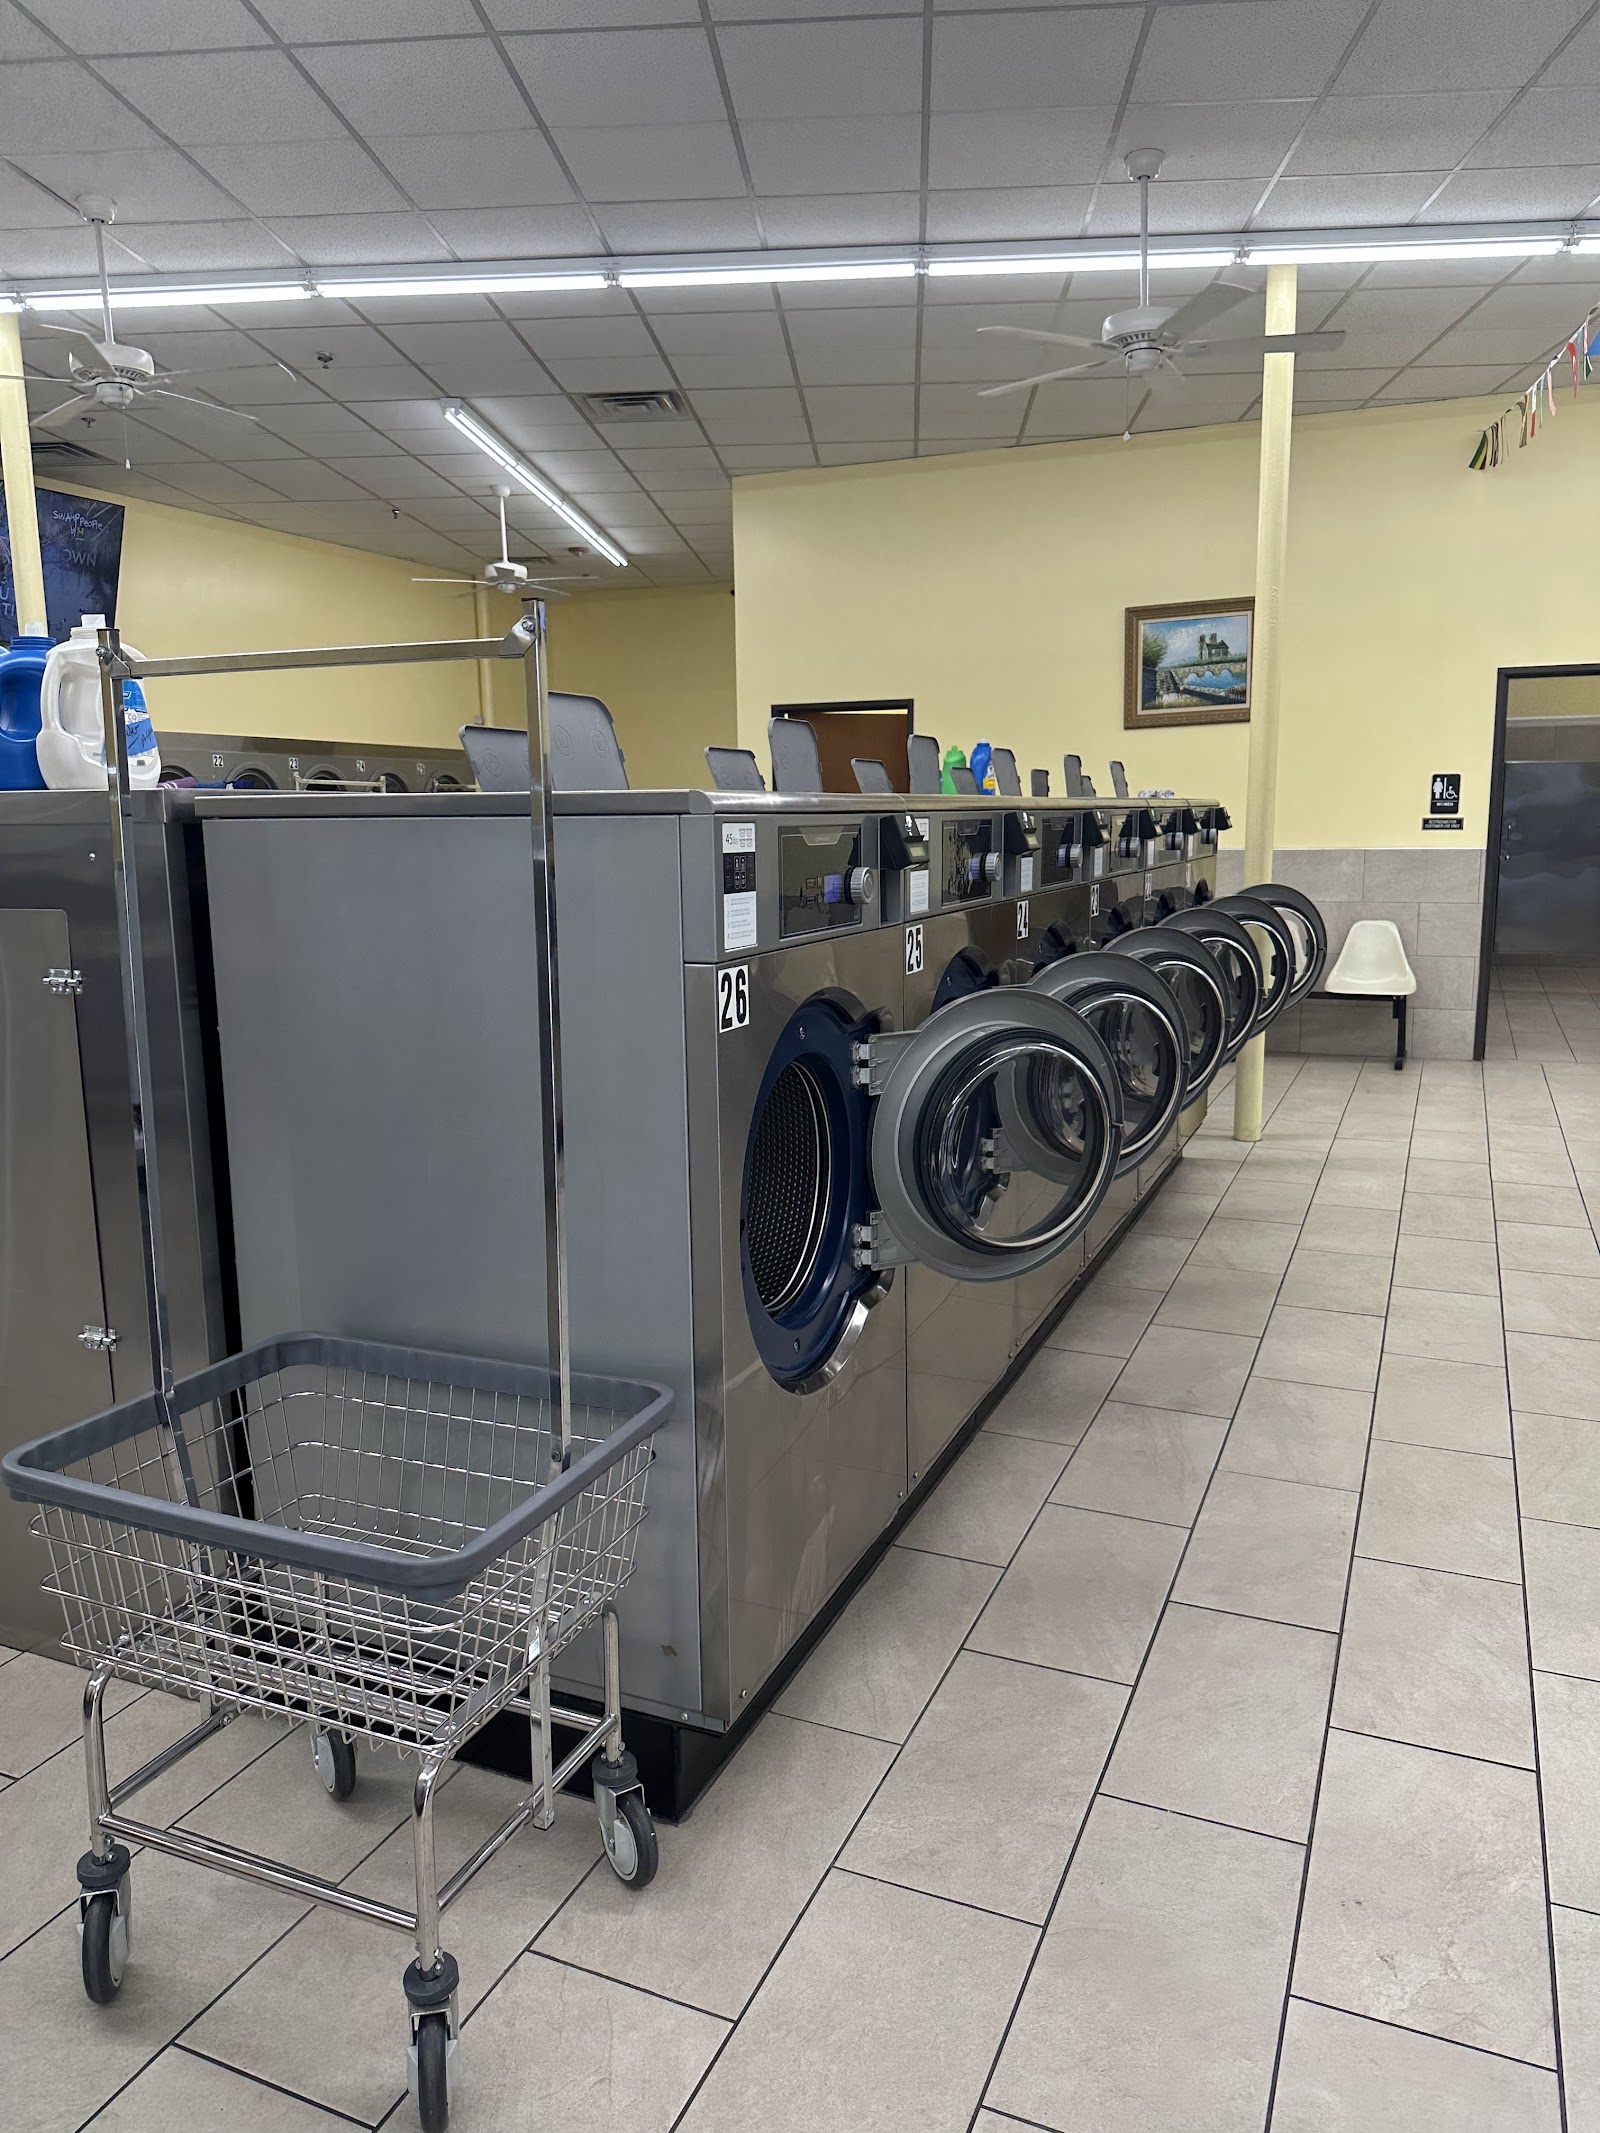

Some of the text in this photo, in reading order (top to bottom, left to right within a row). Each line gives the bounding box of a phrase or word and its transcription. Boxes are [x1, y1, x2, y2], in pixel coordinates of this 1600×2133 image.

[213, 755, 223, 767] 22
[1017, 903, 1028, 938] 24
[907, 926, 922, 972] 25
[720, 968, 747, 1029] 26
